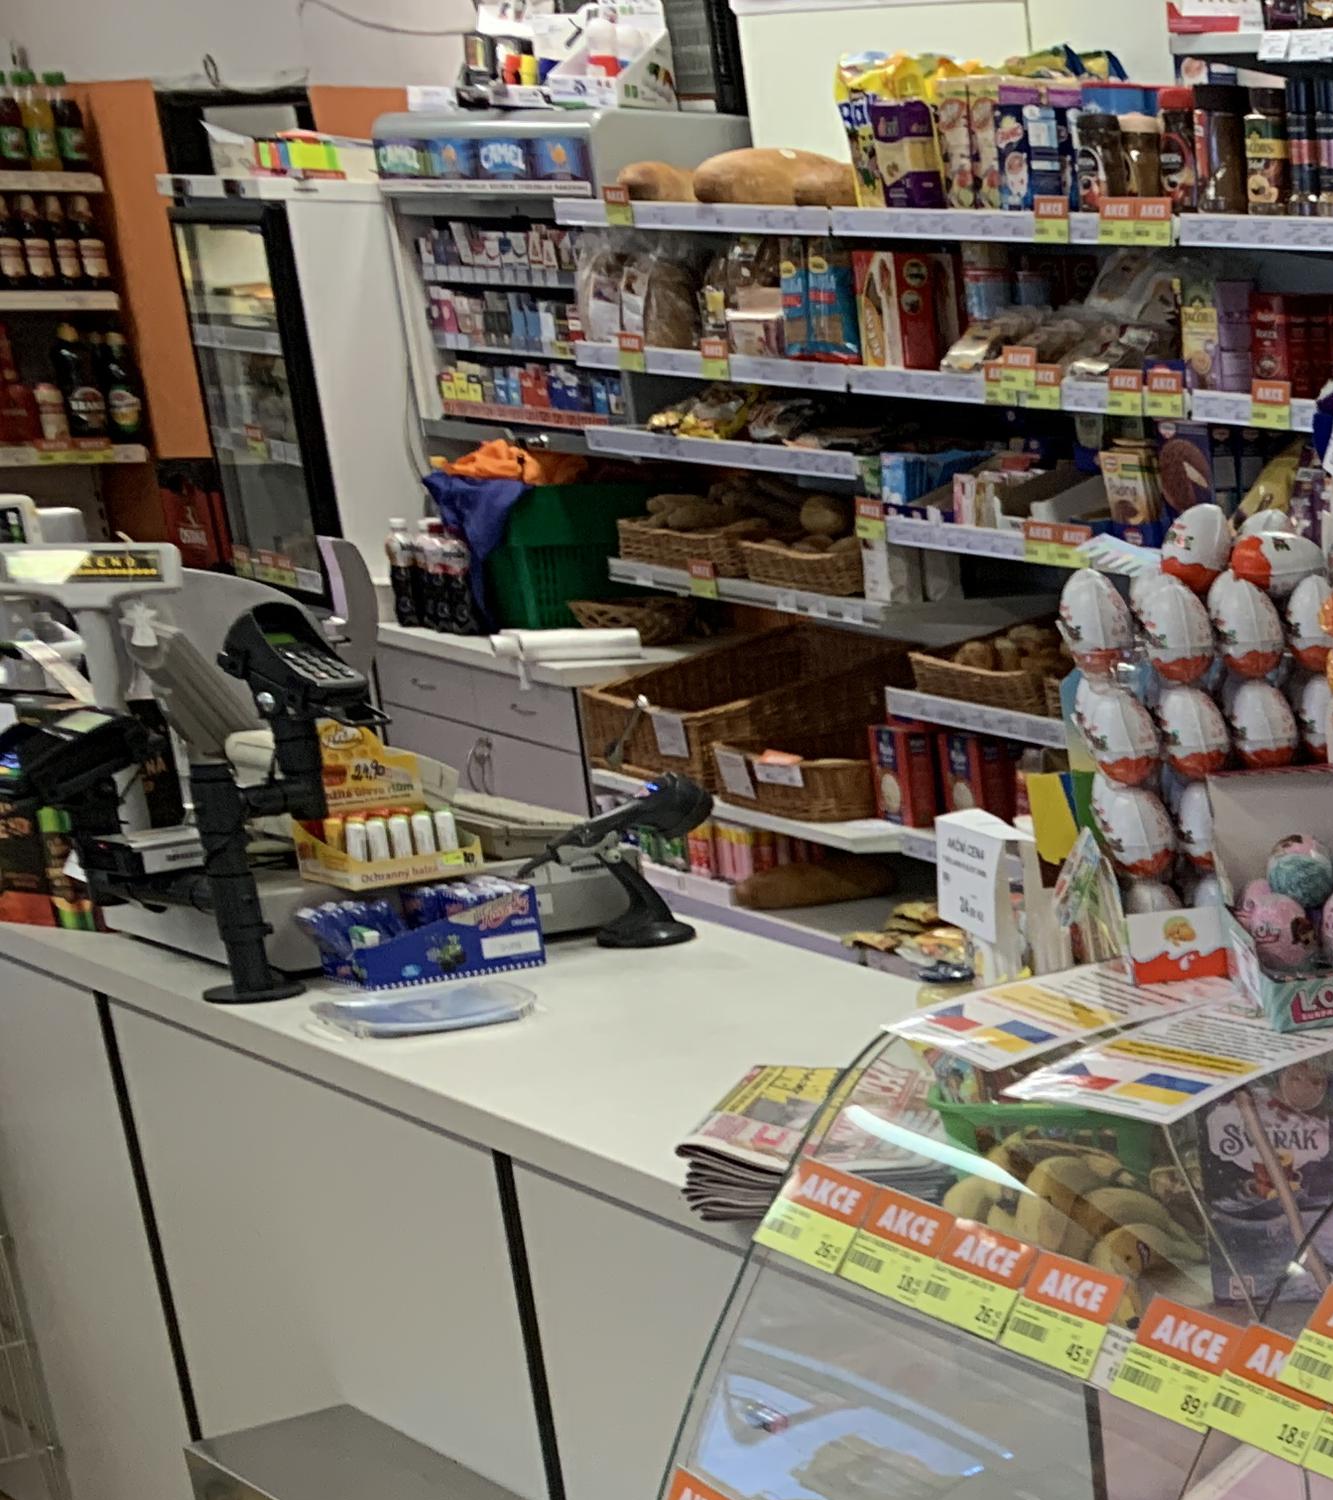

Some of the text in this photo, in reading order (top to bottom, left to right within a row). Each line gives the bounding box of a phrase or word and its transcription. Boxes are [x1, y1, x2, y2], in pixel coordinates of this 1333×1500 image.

[799, 1172, 862, 1216] AKCE
[878, 1200, 940, 1247] AKCE
[955, 1233, 1019, 1278] AKCE
[1040, 1268, 1108, 1313] AKCE
[1151, 1313, 1226, 1365] AKCE
